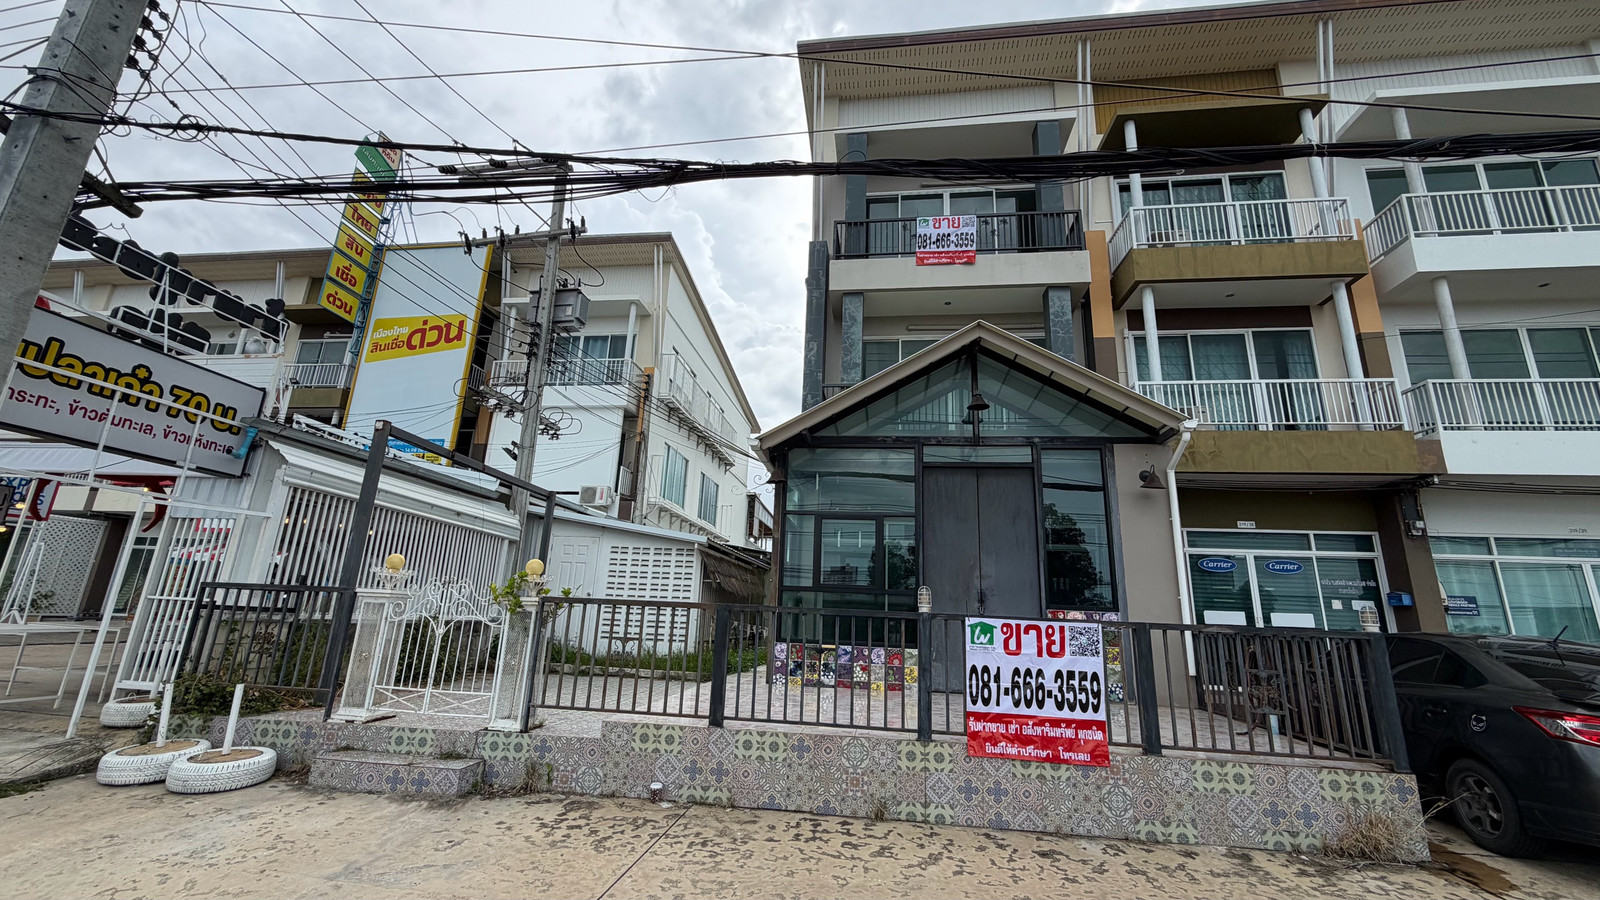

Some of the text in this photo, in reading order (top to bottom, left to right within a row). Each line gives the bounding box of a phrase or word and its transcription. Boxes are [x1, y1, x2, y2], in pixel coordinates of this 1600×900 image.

[351, 203, 373, 233] ไทย
[932, 217, 961, 229] ขาย
[344, 233, 364, 258] สิน
[917, 232, 975, 250] 081-666-3559
[335, 263, 358, 288] เชื่อ
[326, 290, 353, 316] ด่วน
[370, 335, 406, 354] สินเชื่อ
[373, 326, 409, 339] เมืองไทย
[405, 319, 465, 351] ด่วน
[166, 384, 211, 425] 70
[1203, 560, 1233, 568] Carrier
[1269, 562, 1299, 571] Carrier
[1000, 622, 1066, 659] ขาย
[968, 664, 1101, 714] 081-666-3559
[968, 717, 1104, 746] รับฝากขาย เช่า อสังหาริมทรัพย์ ทุกชนิด
[985, 742, 1091, 761] ยินดีให้คำปรึกษา โทรเลย
